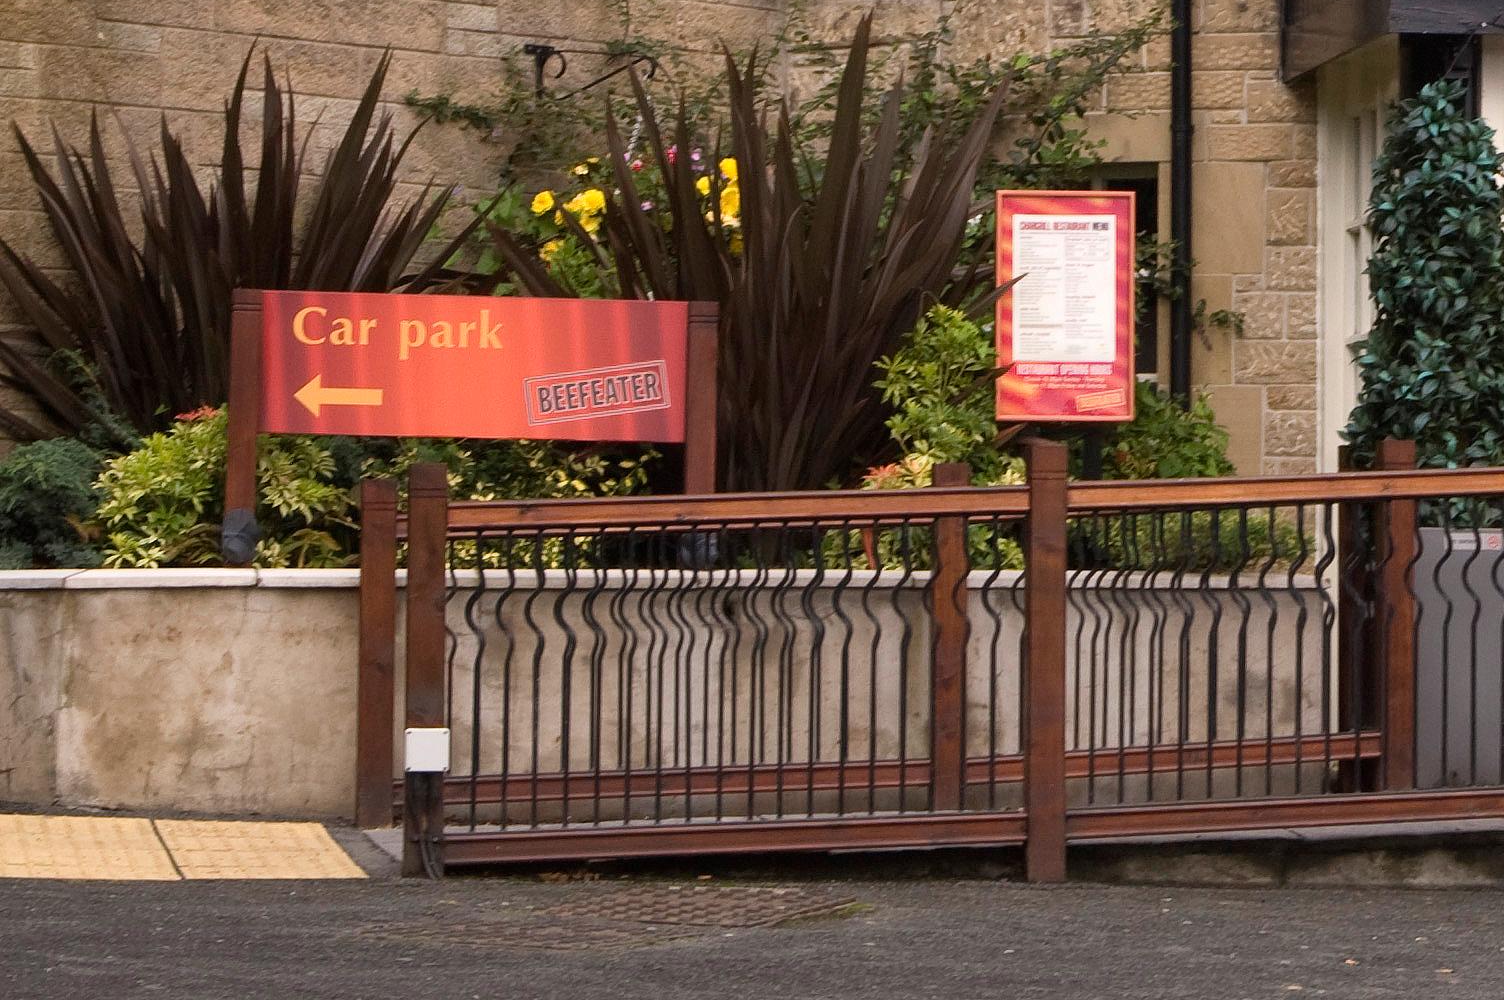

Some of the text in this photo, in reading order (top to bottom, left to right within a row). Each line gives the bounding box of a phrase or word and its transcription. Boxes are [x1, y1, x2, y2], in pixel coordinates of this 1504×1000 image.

[292, 306, 503, 360] Car park
[537, 372, 661, 415] BEEFEATER
